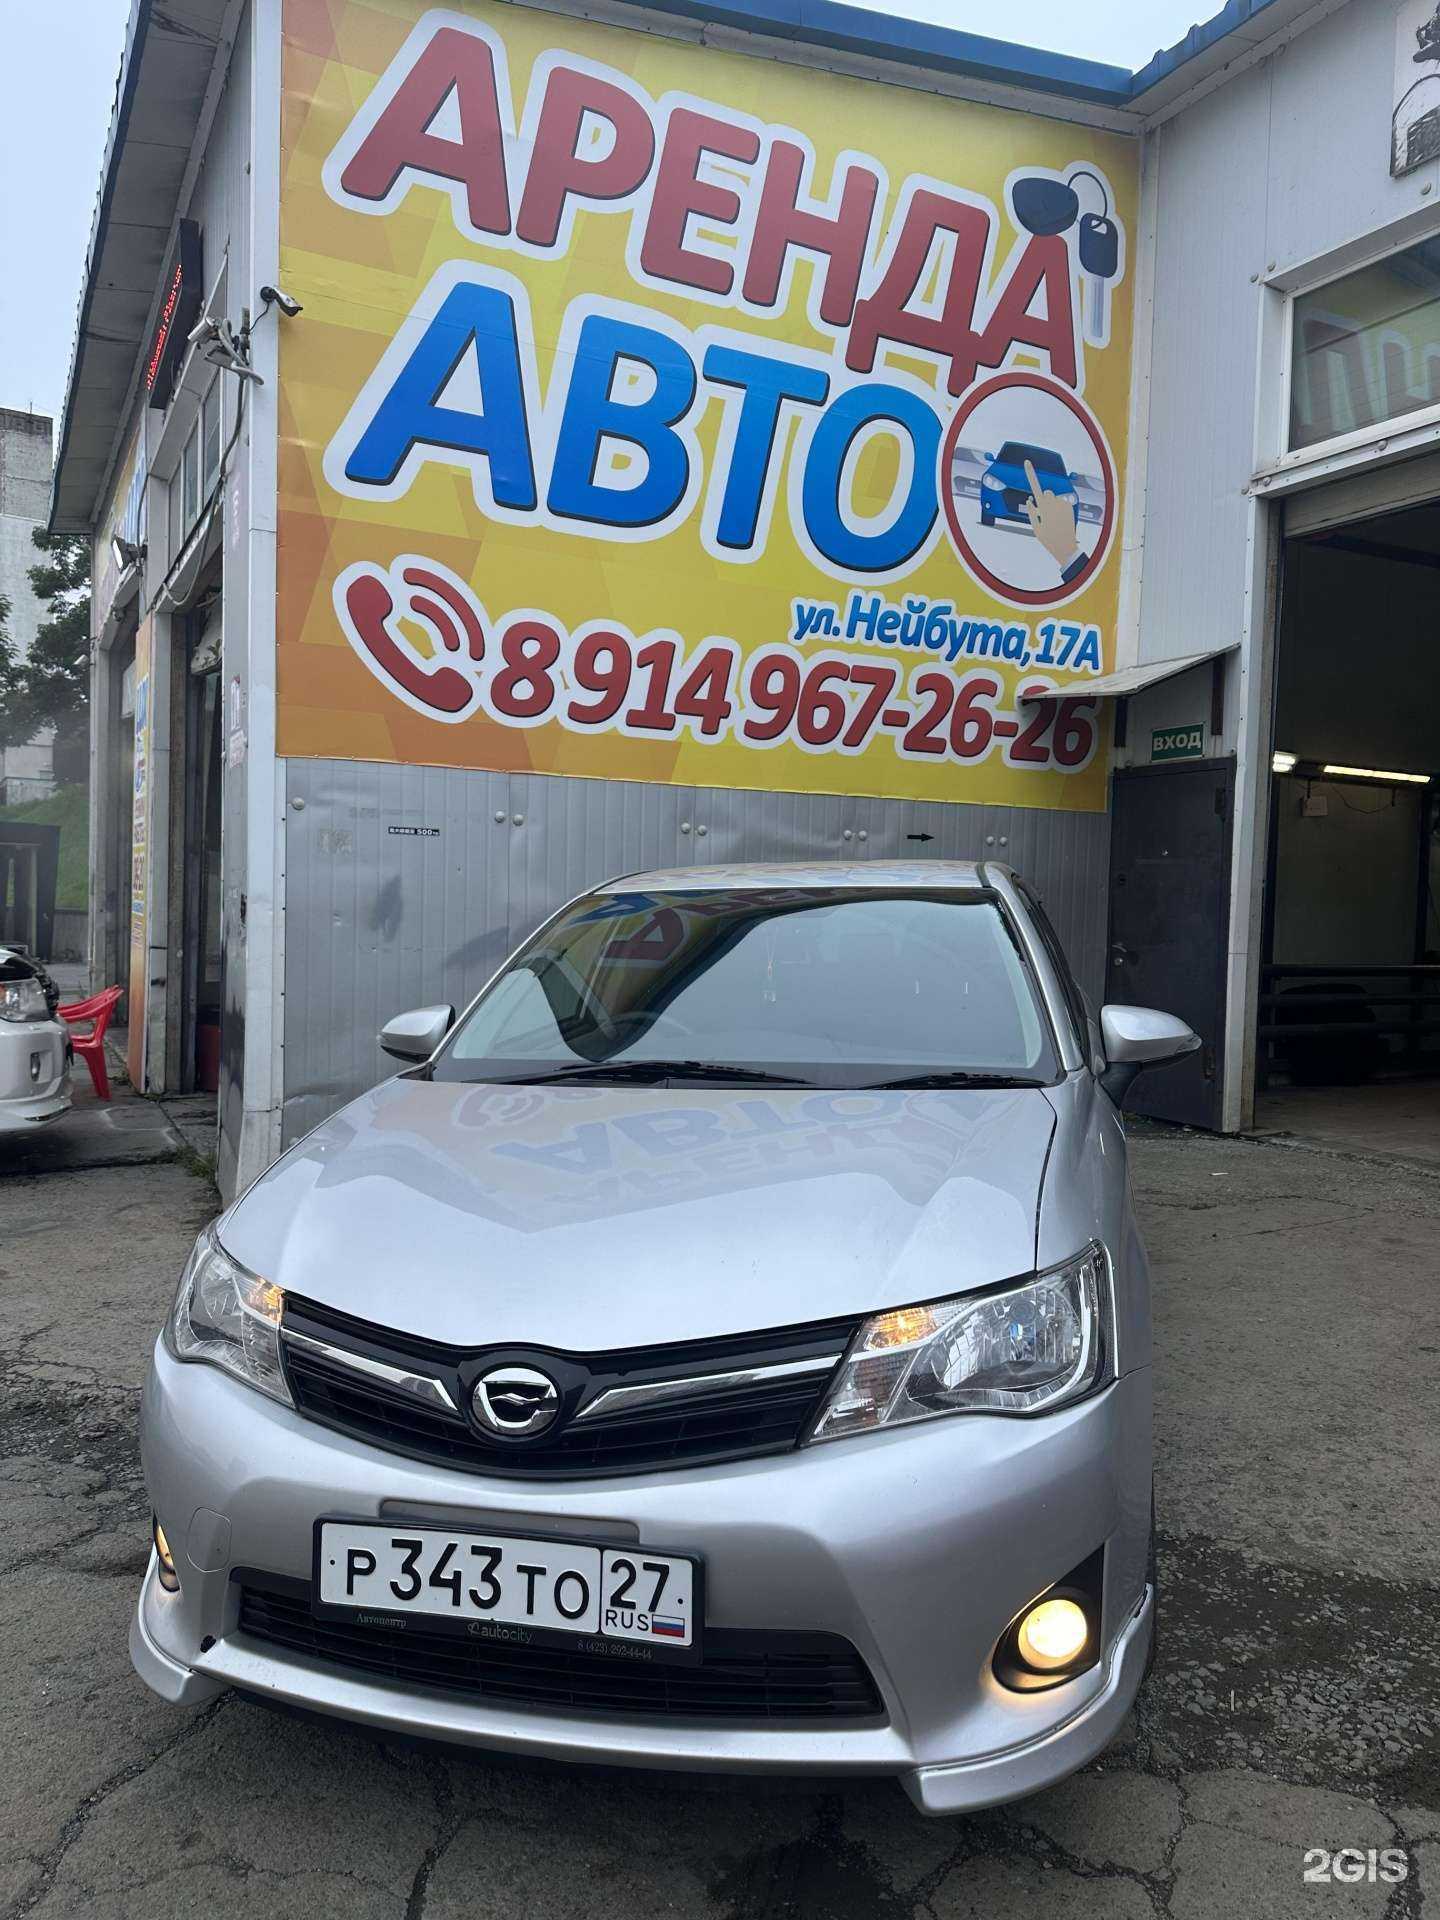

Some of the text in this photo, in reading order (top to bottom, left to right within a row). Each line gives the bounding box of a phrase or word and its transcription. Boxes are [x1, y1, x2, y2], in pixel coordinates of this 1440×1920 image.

[340, 27, 1078, 398] АРЕНДА
[345, 281, 943, 573] АВТО
[490, 621, 1097, 766] 8 914 967-26-26
[1153, 732, 1201, 751] ВХОД
[610, 1558, 671, 1612] 27
[481, 1624, 534, 1645] autocity
[605, 1610, 650, 1632] RUS
